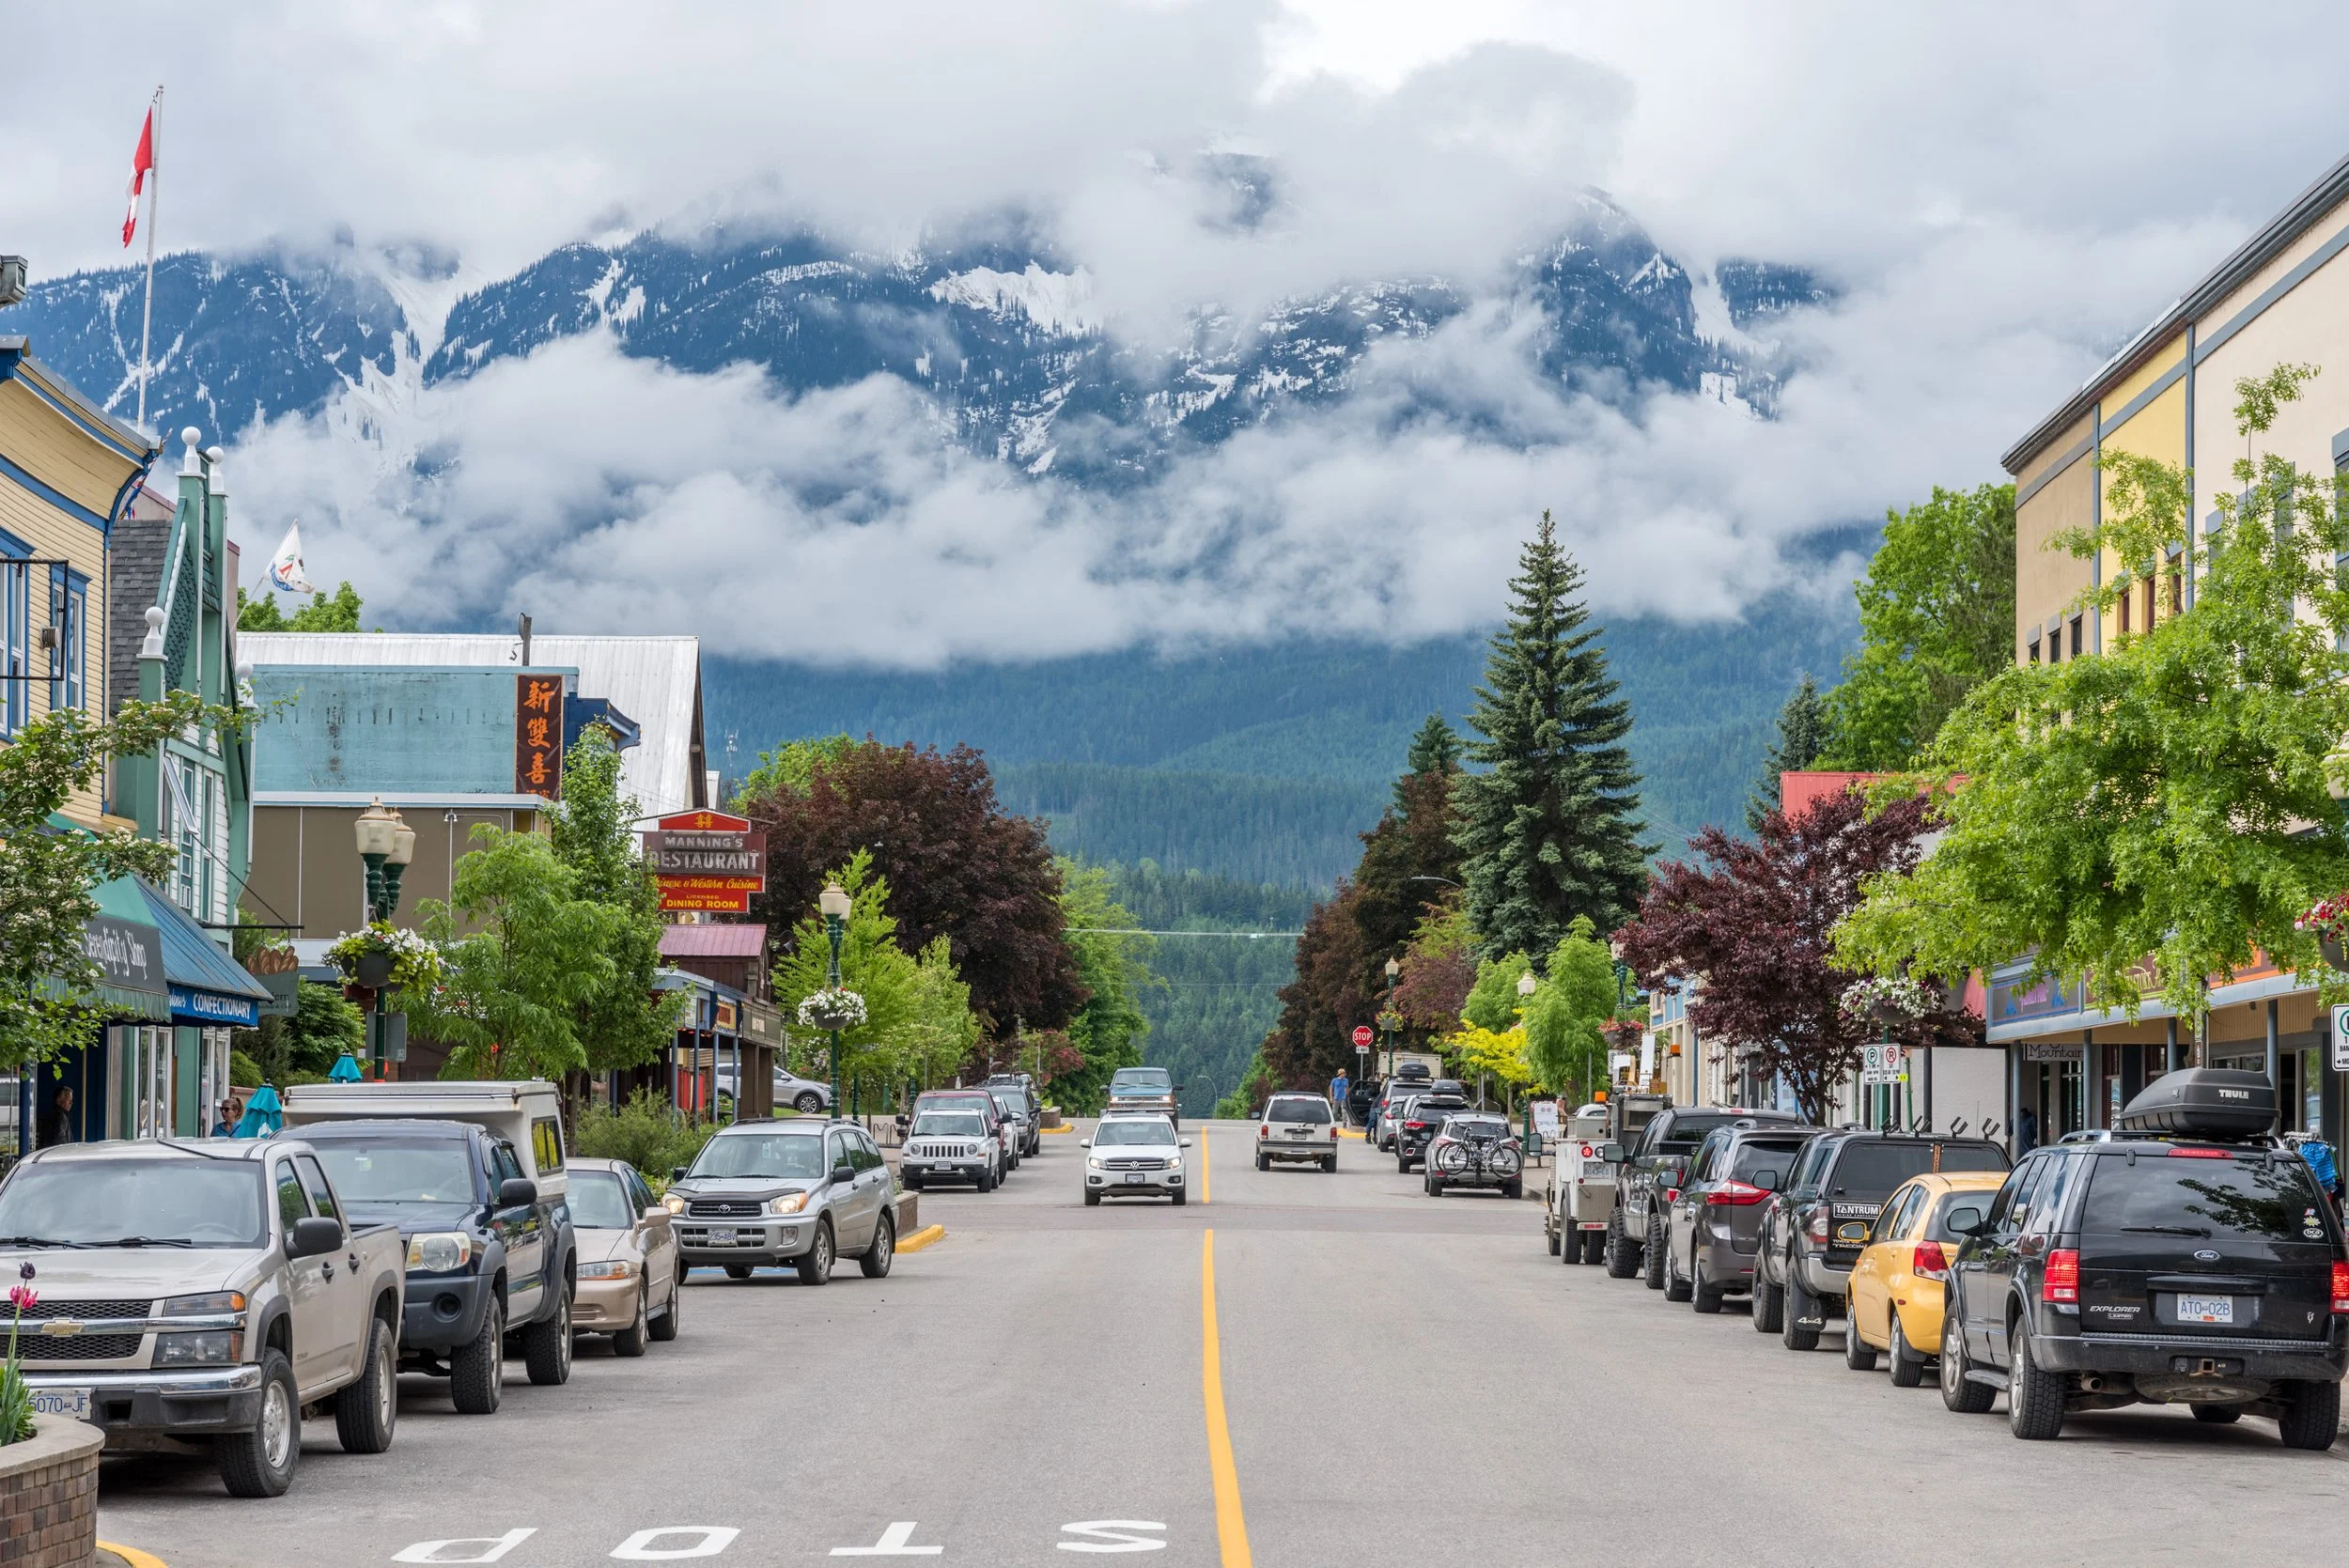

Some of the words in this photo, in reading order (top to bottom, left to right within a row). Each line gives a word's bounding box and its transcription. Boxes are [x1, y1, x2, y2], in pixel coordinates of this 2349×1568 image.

[664, 835, 744, 848] MANNING'S
[690, 877, 723, 889] Western
[726, 877, 759, 890] Cuisine
[707, 900, 739, 908] ROOM
[125, 929, 148, 981] Shop
[193, 993, 251, 1020] CONFECTIONARY
[1354, 1032, 1372, 1041] STOP
[2218, 1089, 2249, 1099] THULE
[1835, 1204, 1879, 1216] TANTRUM
[2089, 1305, 2141, 1313] EXPLORER
